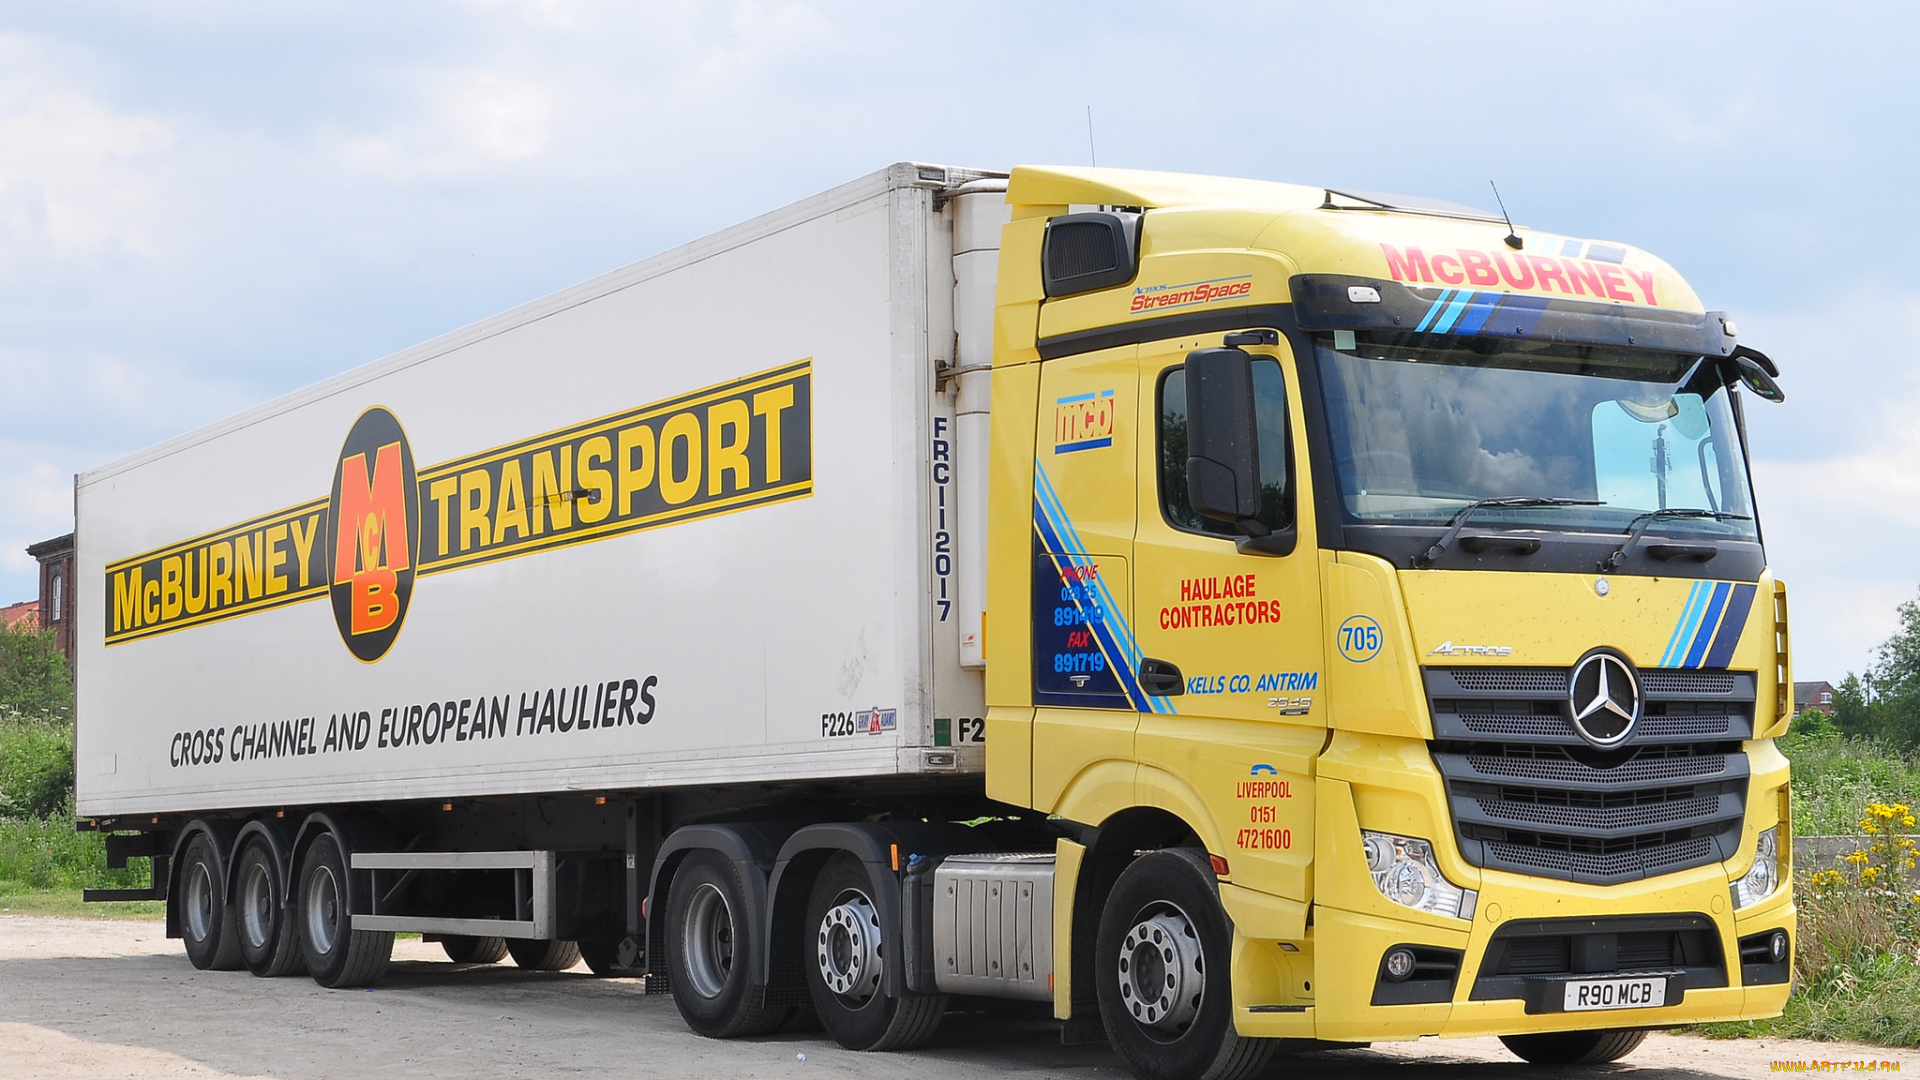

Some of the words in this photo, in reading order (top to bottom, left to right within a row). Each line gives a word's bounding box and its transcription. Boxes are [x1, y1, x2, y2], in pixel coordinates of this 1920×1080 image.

[1380, 242, 1658, 306] McBURNEY
[1131, 282, 1252, 311] StreamSpace
[113, 514, 319, 632] McBURNEY
[430, 384, 794, 556] TRANSPORT
[1060, 564, 1098, 582] PHONE
[1083, 584, 1097, 600] 25
[1180, 574, 1256, 602] HAULAGE
[1054, 604, 1104, 626] 891419
[1159, 600, 1281, 630] CONTRACTORS
[1067, 631, 1091, 648] FAX
[1343, 627, 1378, 652] 705
[1054, 651, 1104, 672] 891719
[1186, 675, 1226, 695] KELLS
[1229, 674, 1251, 693] CO.
[1255, 671, 1318, 692] ANTRIM
[170, 727, 225, 767] CROSS
[230, 716, 317, 762] CHANNEL
[323, 711, 371, 753] AND
[377, 694, 510, 748] EUROPEAN
[516, 675, 658, 737] HAULIERS
[822, 713, 854, 737] F226
[1236, 781, 1292, 799] LIVERPOOL
[1250, 806, 1276, 824] 0151
[1236, 829, 1291, 850] 4721600
[1578, 985, 1614, 1006] R90
[1618, 983, 1652, 1004] MCB
